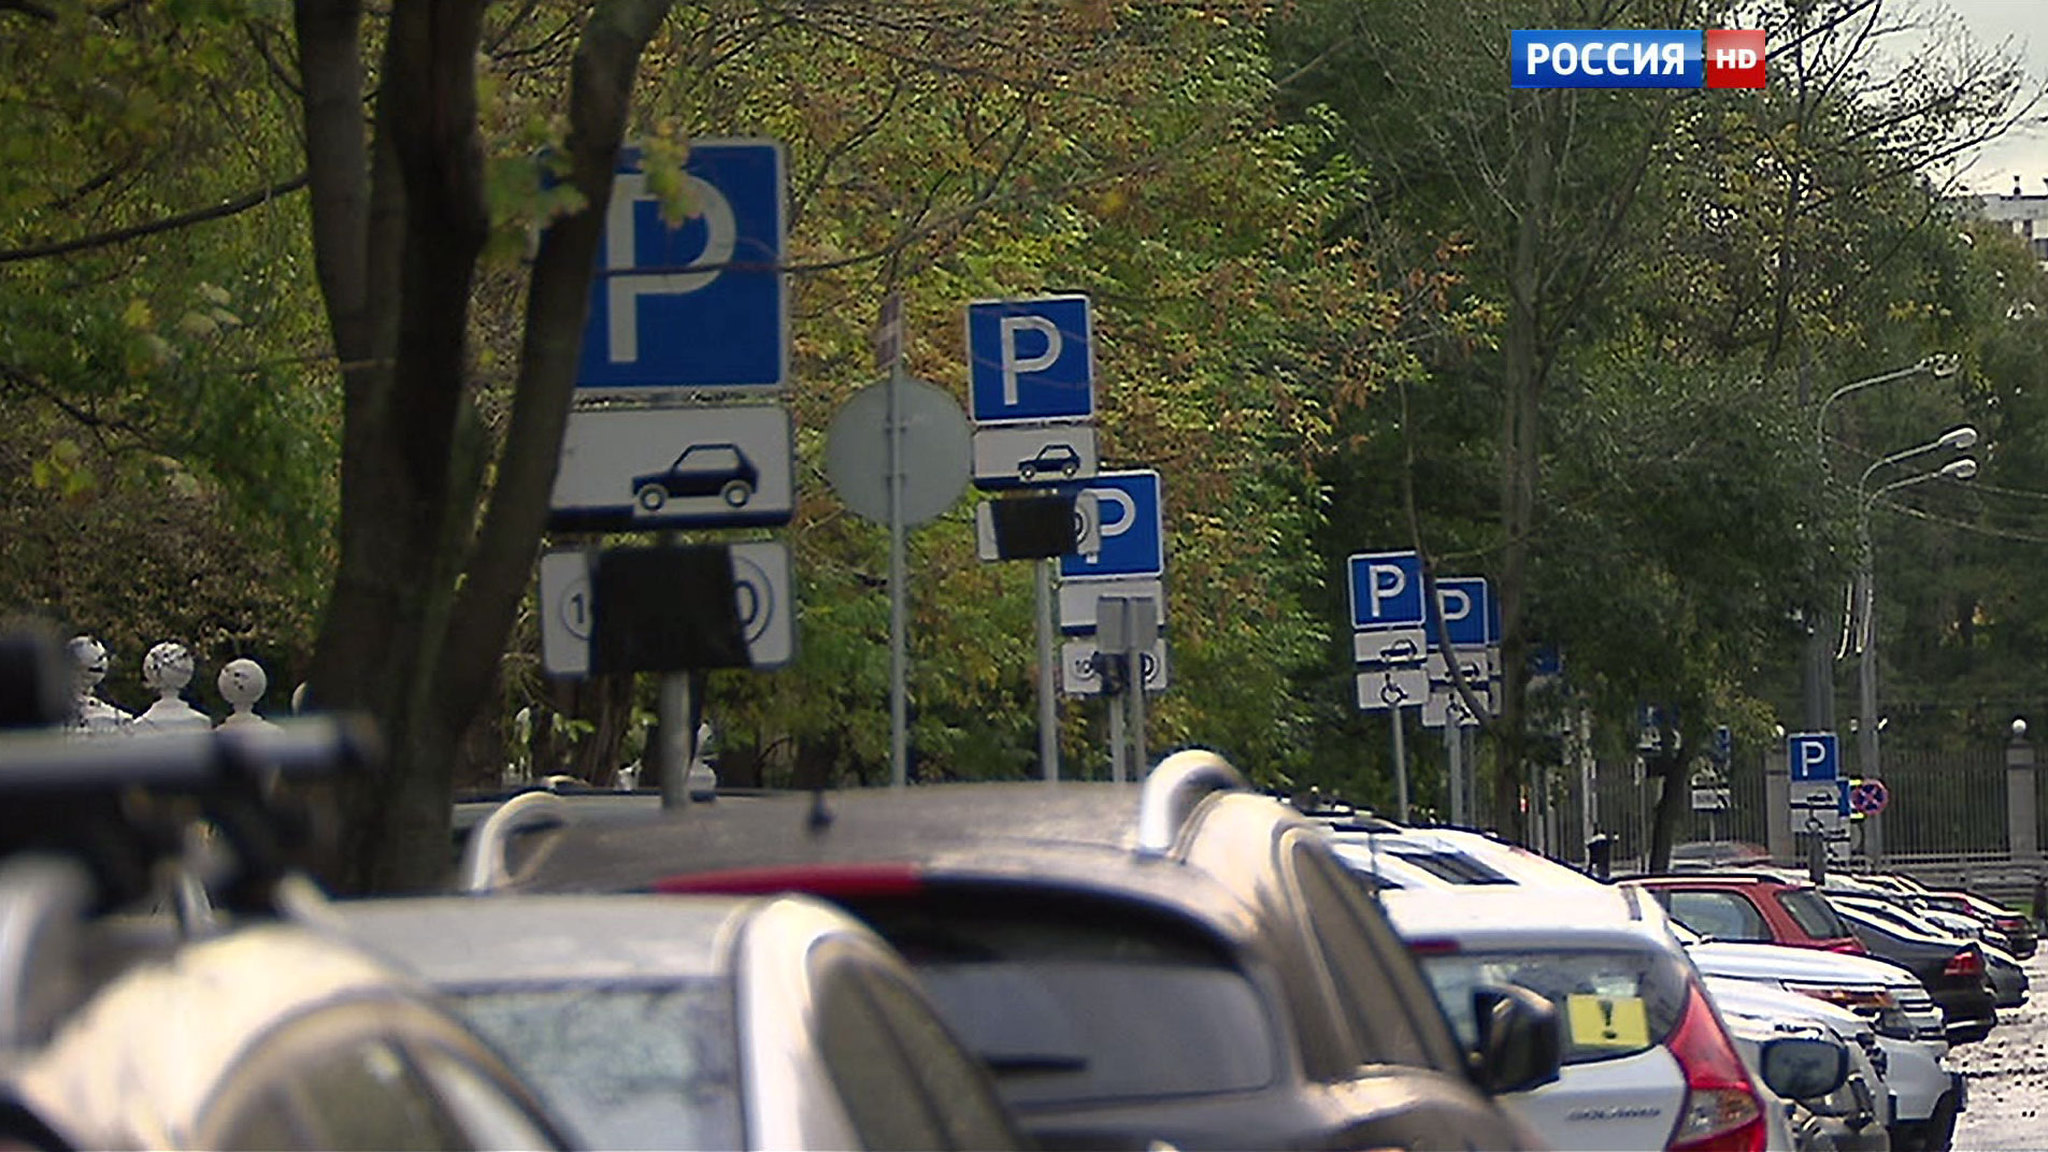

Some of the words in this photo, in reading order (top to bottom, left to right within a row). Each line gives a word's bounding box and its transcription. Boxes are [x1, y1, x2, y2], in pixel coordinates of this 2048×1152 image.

[606, 174, 737, 363] P
[1001, 316, 1062, 405] P
[1085, 487, 1136, 564] P
[1369, 564, 1406, 617] P
[1436, 589, 1471, 621] P
[1801, 741, 1826, 777] P
